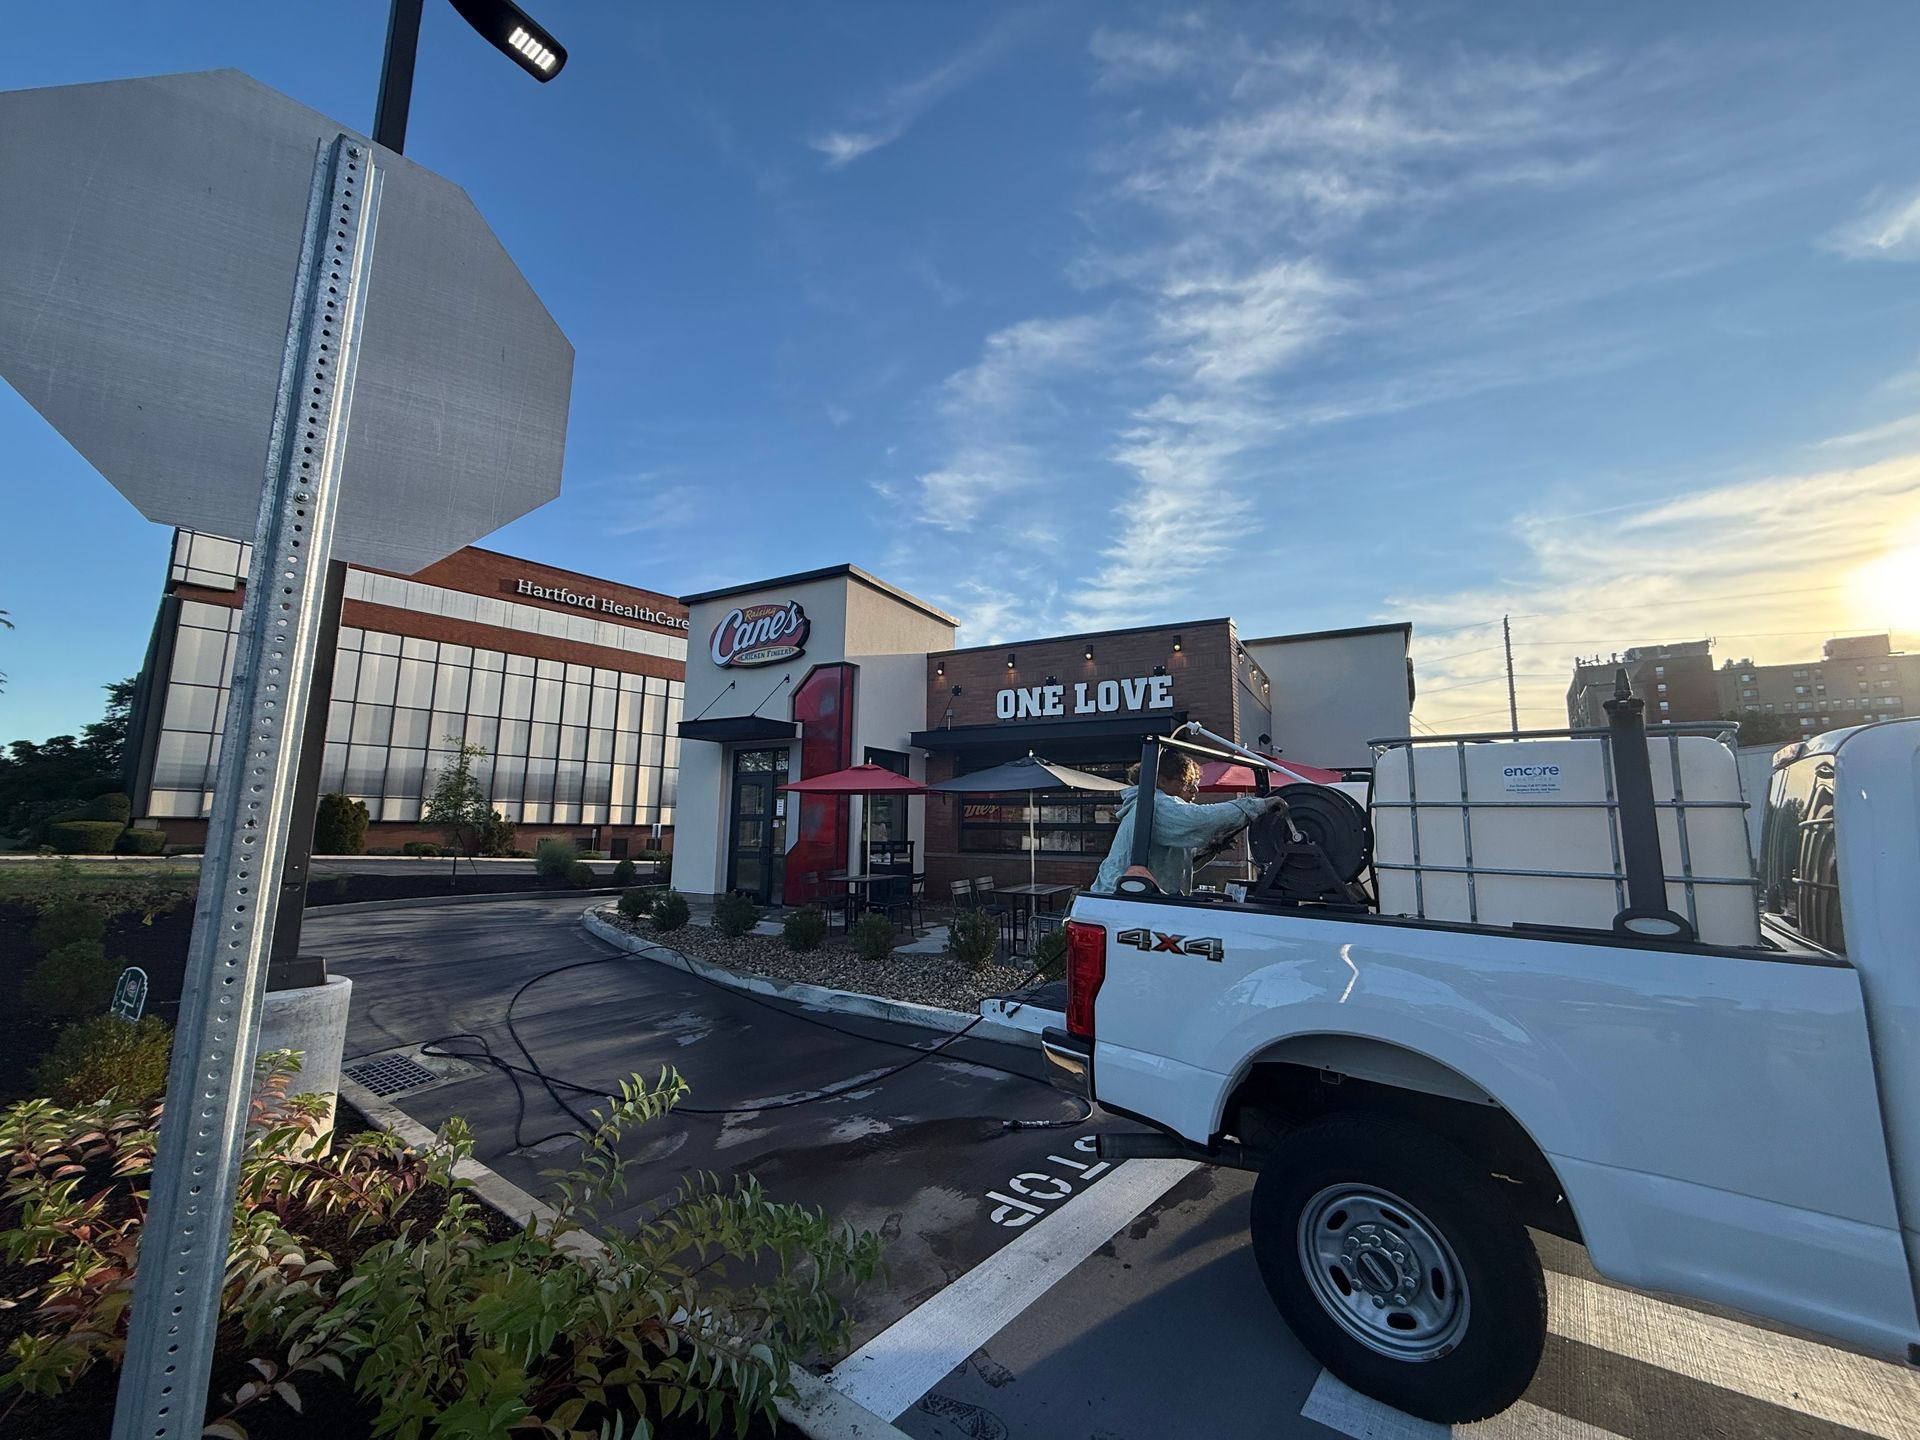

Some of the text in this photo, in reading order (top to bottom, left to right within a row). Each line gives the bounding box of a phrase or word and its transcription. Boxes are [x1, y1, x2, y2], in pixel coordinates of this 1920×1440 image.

[516, 578, 690, 630] Hartford HealthCare
[744, 606, 776, 621] Raising
[711, 600, 803, 665] Cane's
[996, 675, 1174, 719] ONE LOVE
[1504, 766, 1560, 776] encore
